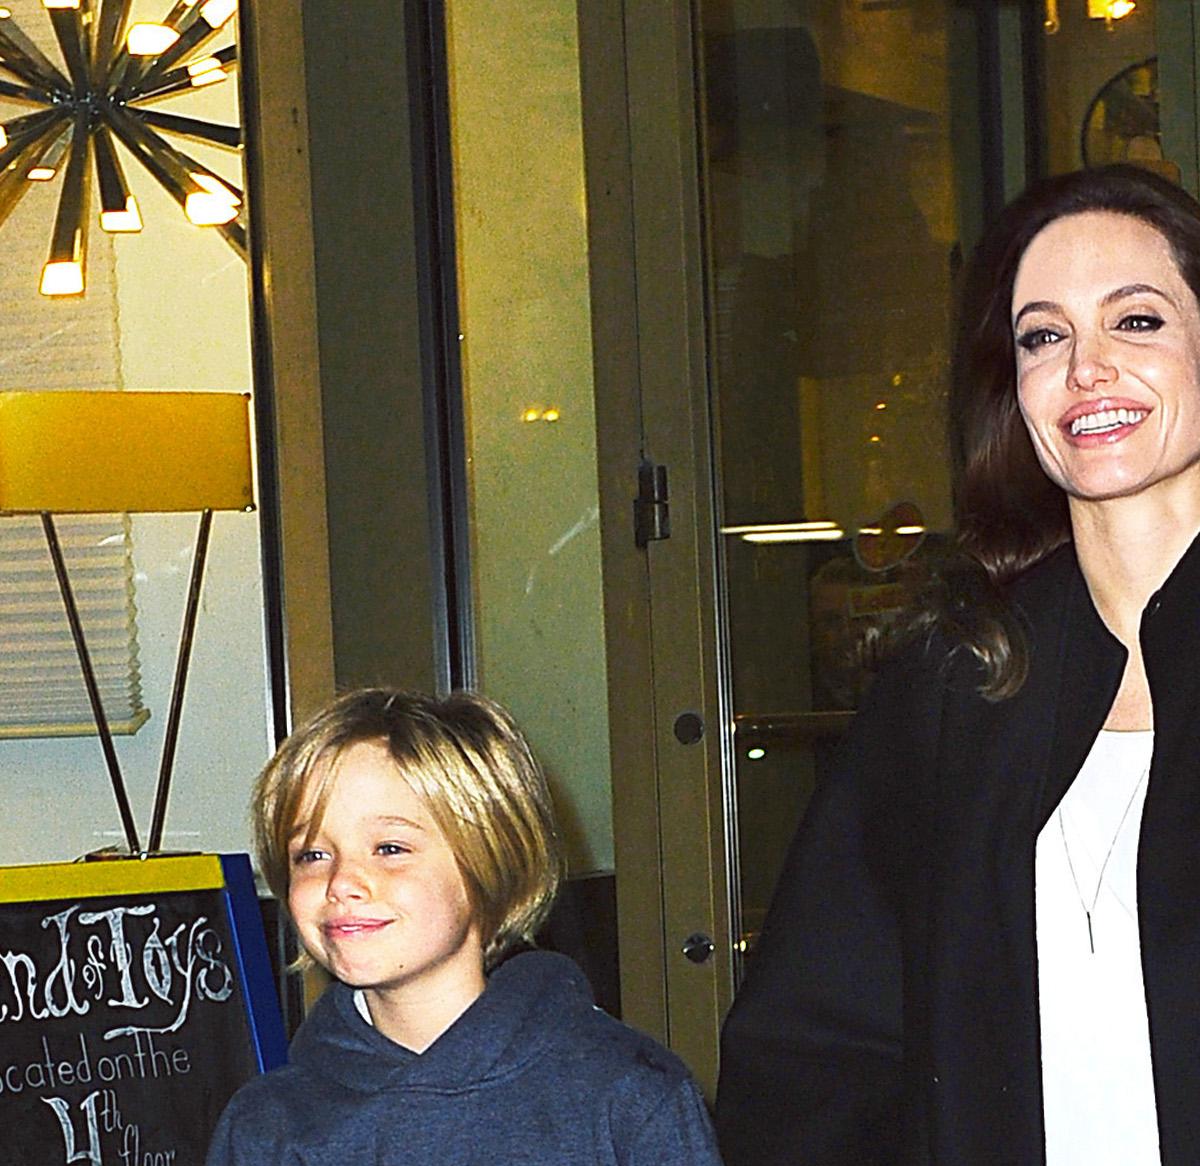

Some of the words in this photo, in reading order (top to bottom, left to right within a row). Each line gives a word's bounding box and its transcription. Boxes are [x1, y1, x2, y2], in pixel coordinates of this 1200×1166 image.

[0, 903, 90, 1022] nd
[78, 903, 233, 1041] Toys
[82, 934, 106, 1000] of
